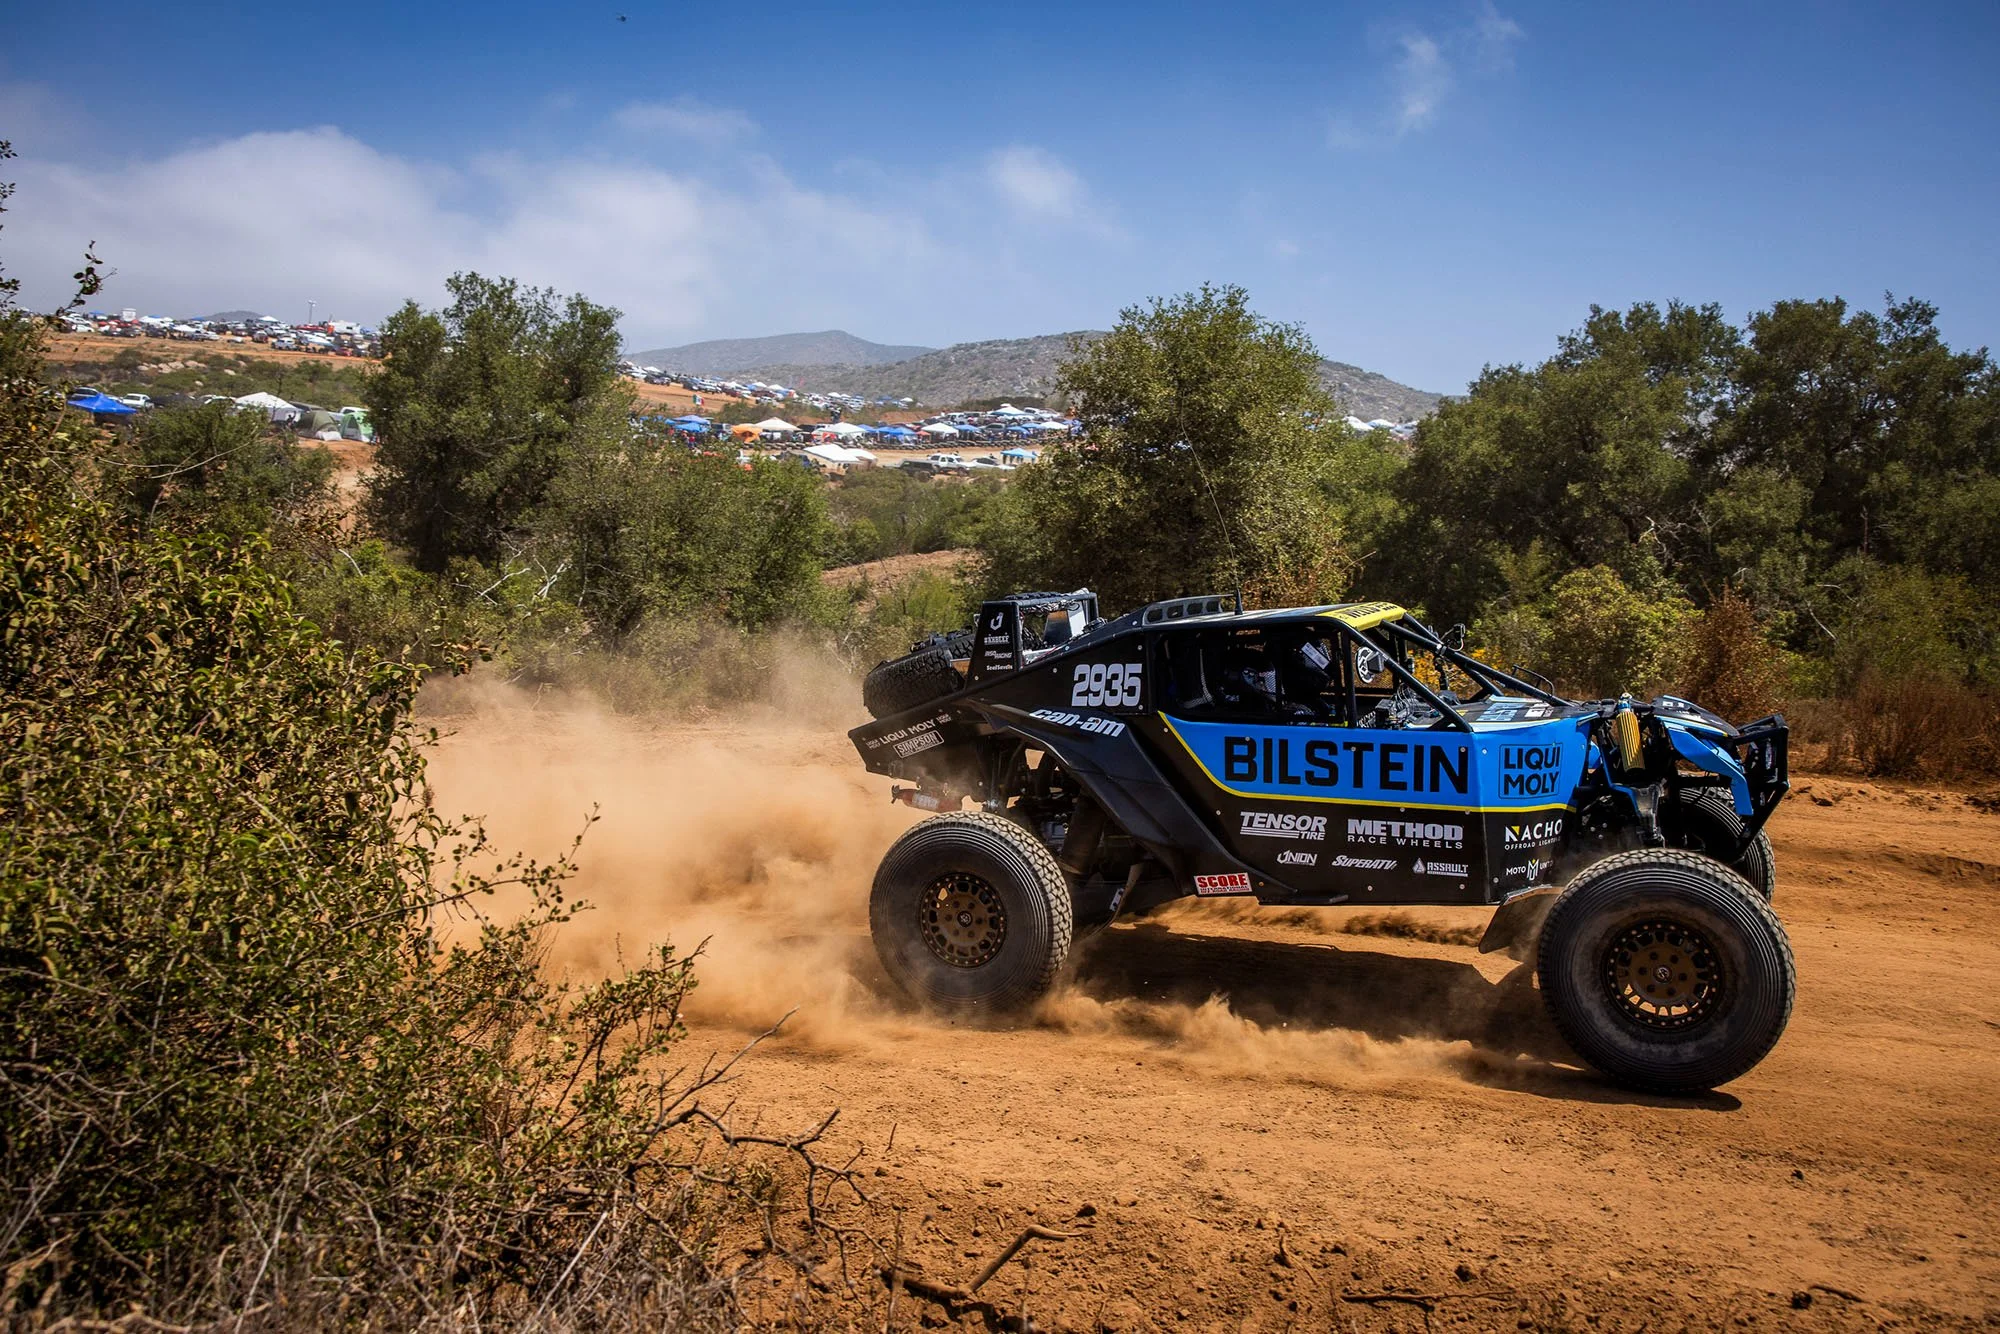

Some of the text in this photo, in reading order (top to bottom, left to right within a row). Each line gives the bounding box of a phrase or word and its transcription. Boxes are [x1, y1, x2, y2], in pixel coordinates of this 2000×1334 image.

[1071, 663, 1142, 706] 2935
[879, 719, 936, 744] LIQUI MOLY
[897, 732, 940, 753] SIMPSON
[1224, 736, 1468, 794] BILSTEIN
[1504, 746, 1560, 770] LIQUI
[1504, 771, 1559, 795] MOLY
[1240, 811, 1327, 832] TENSOR
[1347, 818, 1463, 840] METHOD
[1505, 819, 1563, 842] NACHO
[1300, 831, 1326, 840] TIRE
[1347, 834, 1463, 849] RACE WHEELS
[1504, 841, 1536, 850] OFFROAD
[1276, 850, 1318, 865] UNION
[1427, 861, 1469, 873] ASSAULT
[1197, 874, 1248, 888] SCORE
[1506, 865, 1527, 876] MOTO
